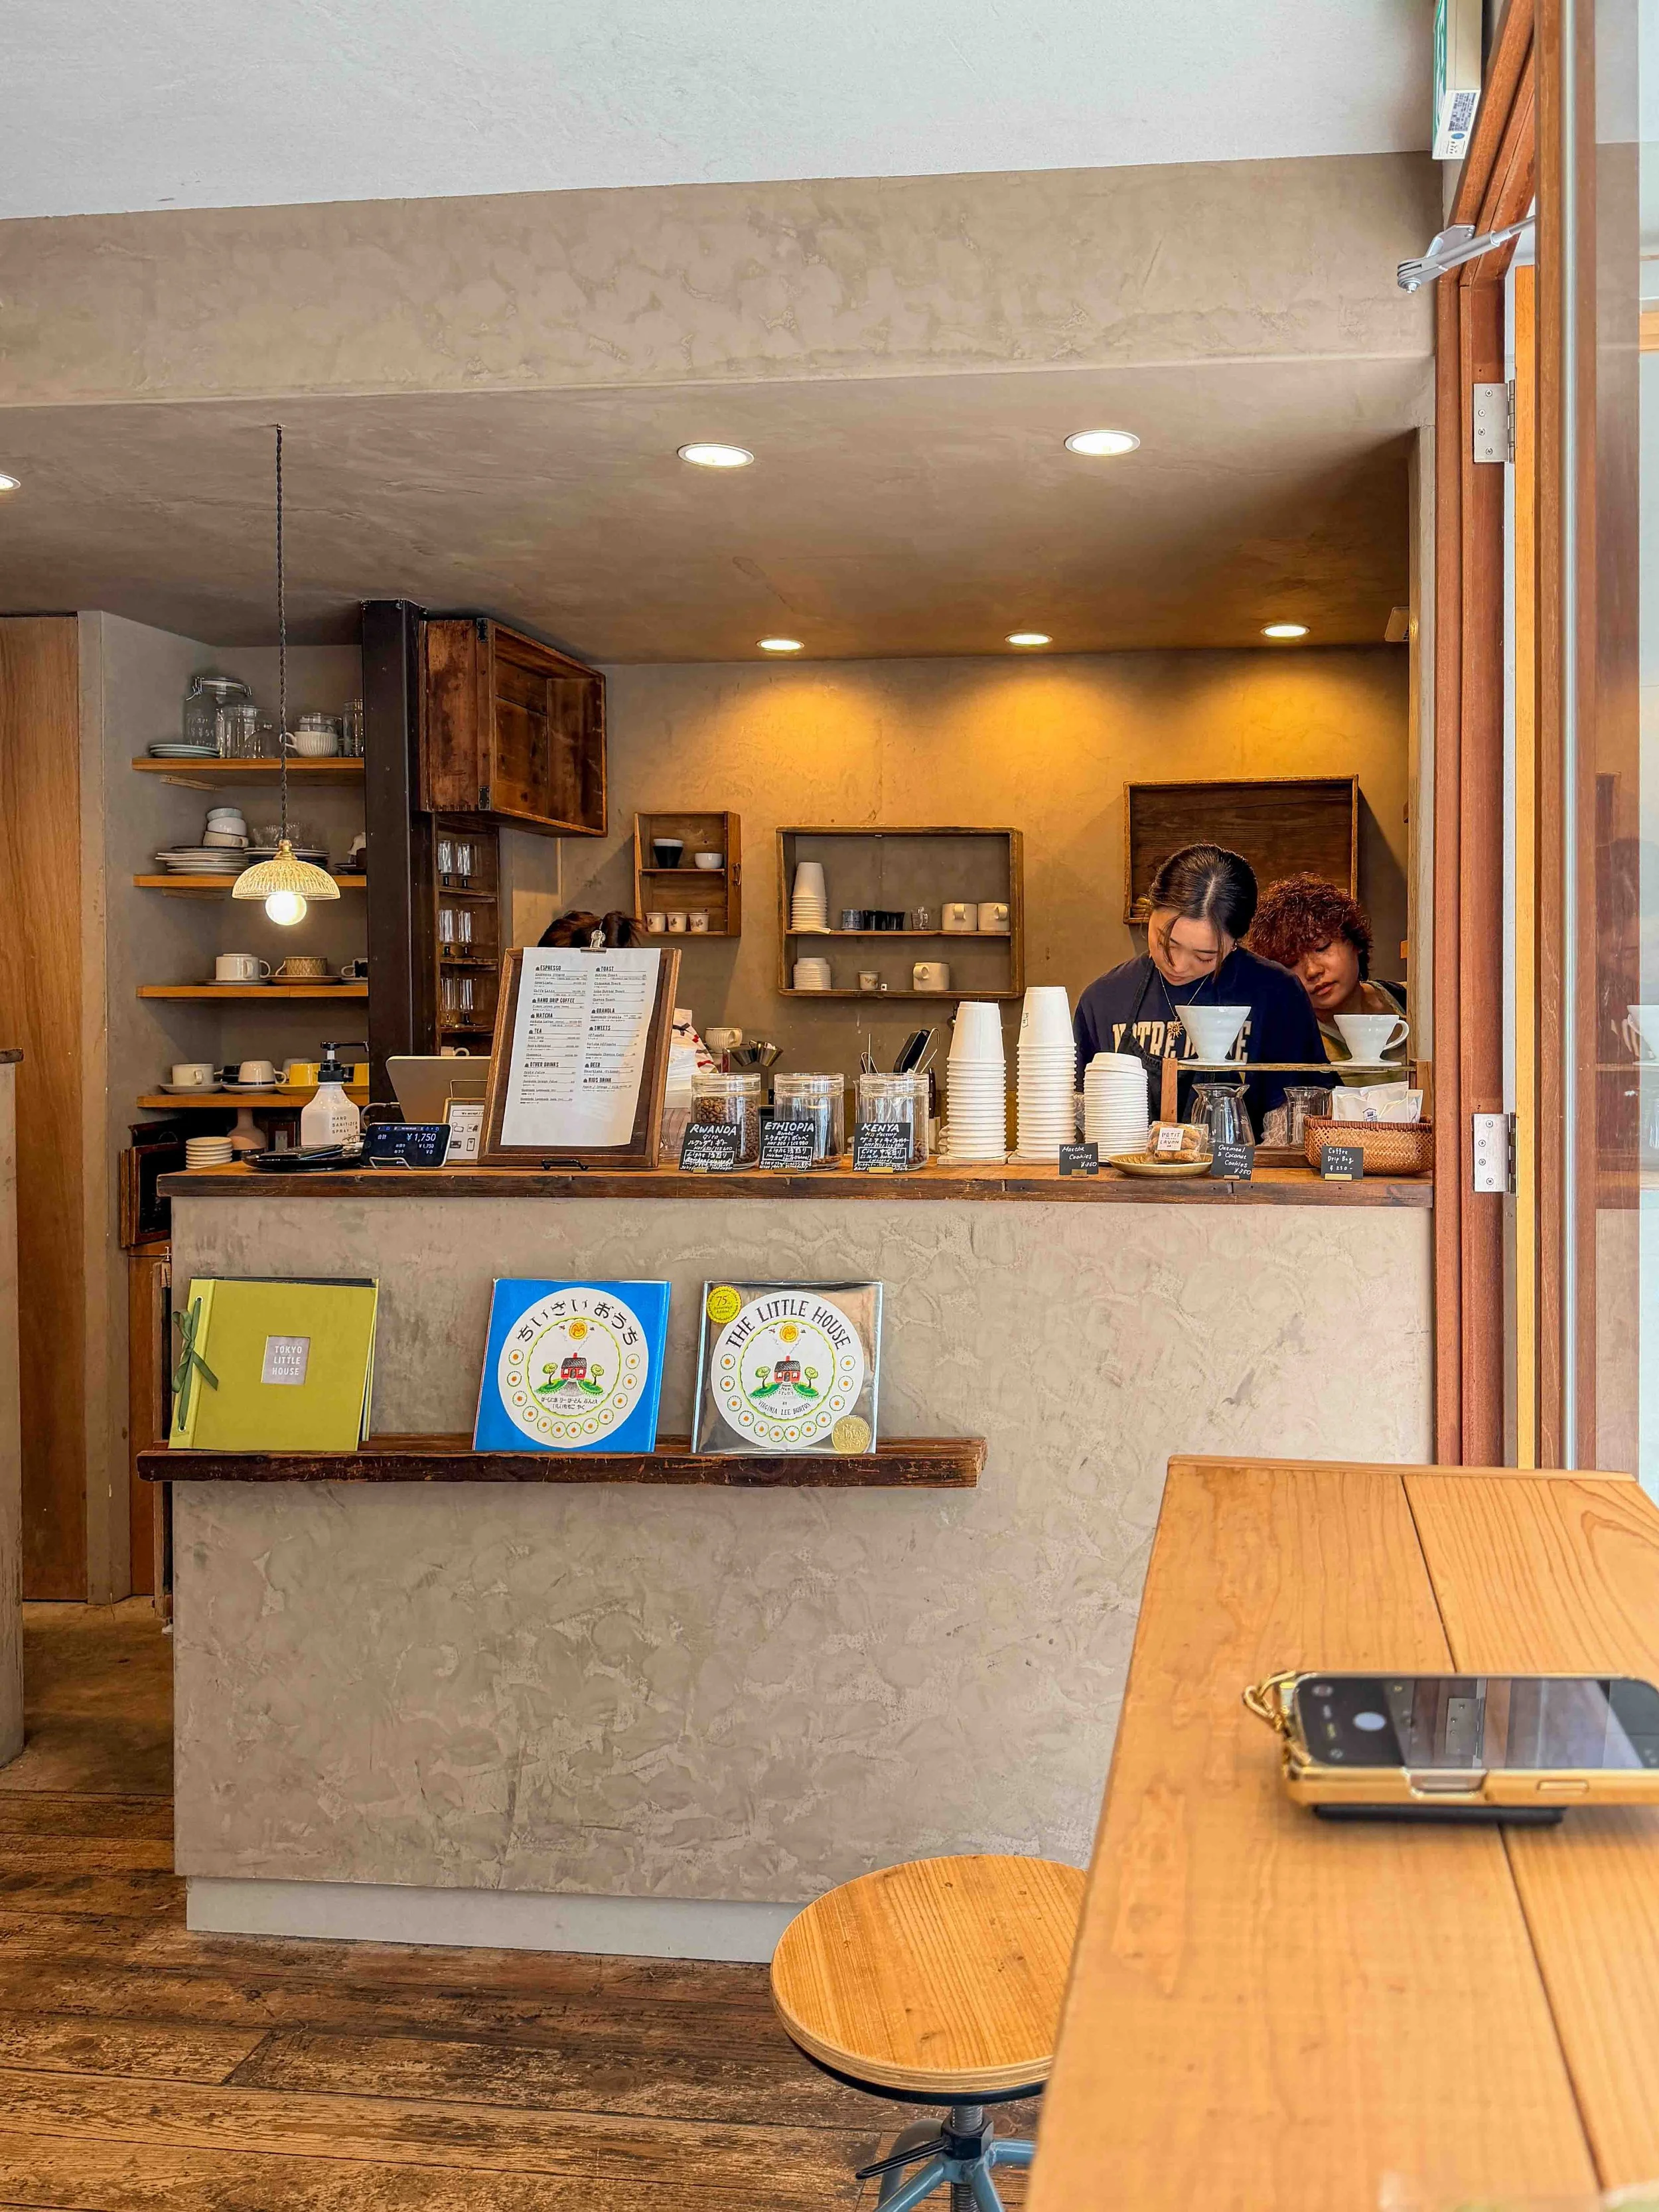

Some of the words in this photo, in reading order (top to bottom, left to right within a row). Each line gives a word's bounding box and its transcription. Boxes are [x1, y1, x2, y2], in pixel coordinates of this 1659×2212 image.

[1113, 1021, 1181, 1059] NTRE
[689, 1124, 737, 1136] RWANDA
[764, 1122, 814, 1132] ETHIOPIA
[861, 1123, 899, 1132] KENYA
[1224, 1159, 1248, 1168] Cookies
[725, 1315, 755, 1349] THE
[755, 1299, 810, 1323] LITTLE
[812, 1306, 851, 1350] HOUSE
[275, 1345, 303, 1354] TOKYO
[273, 1356, 301, 1364] LITTLE
[758, 1400, 778, 1415] VIRGINIA
[793, 1402, 812, 1415] BURTON
